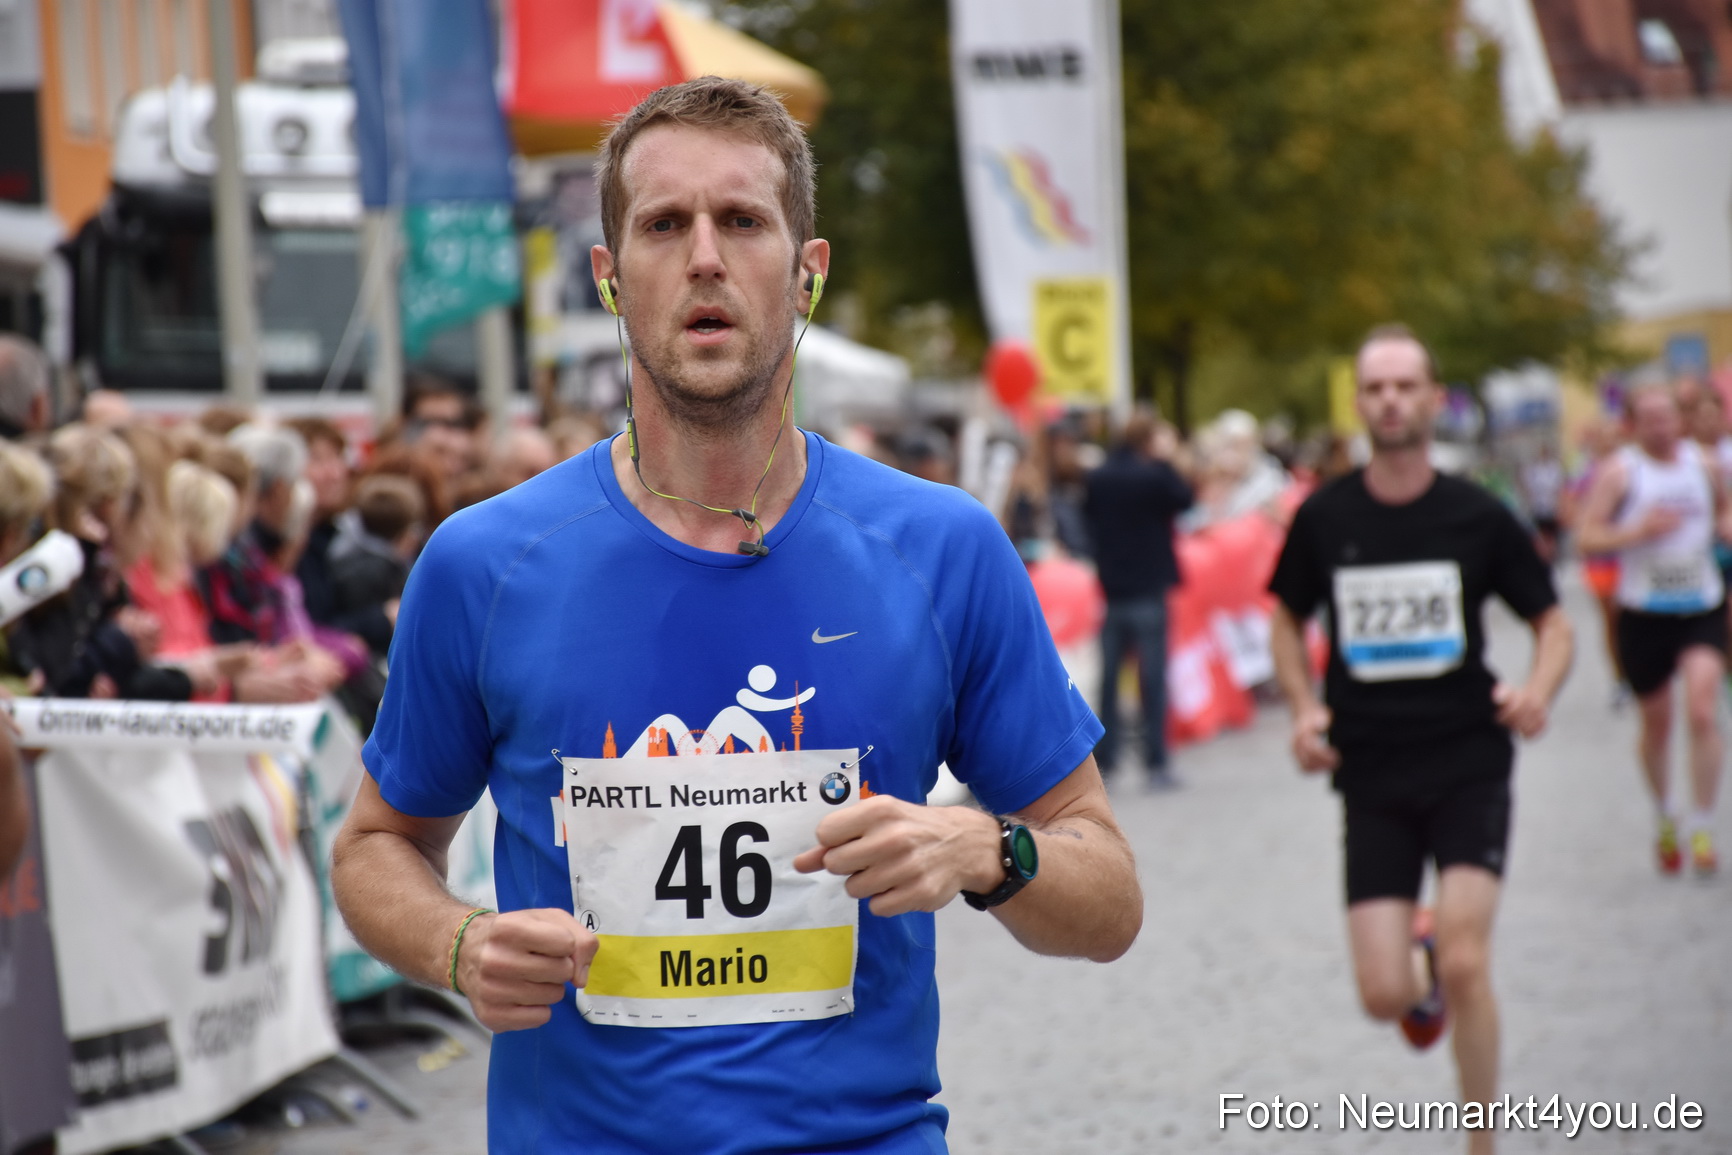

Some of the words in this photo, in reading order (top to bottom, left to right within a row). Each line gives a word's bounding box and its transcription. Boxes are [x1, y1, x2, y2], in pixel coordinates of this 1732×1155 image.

[571, 785, 662, 809] PARTL
[670, 780, 808, 808] Neumarkt
[654, 821, 773, 920] 46
[585, 913, 596, 930] A
[660, 947, 768, 987] Mario
